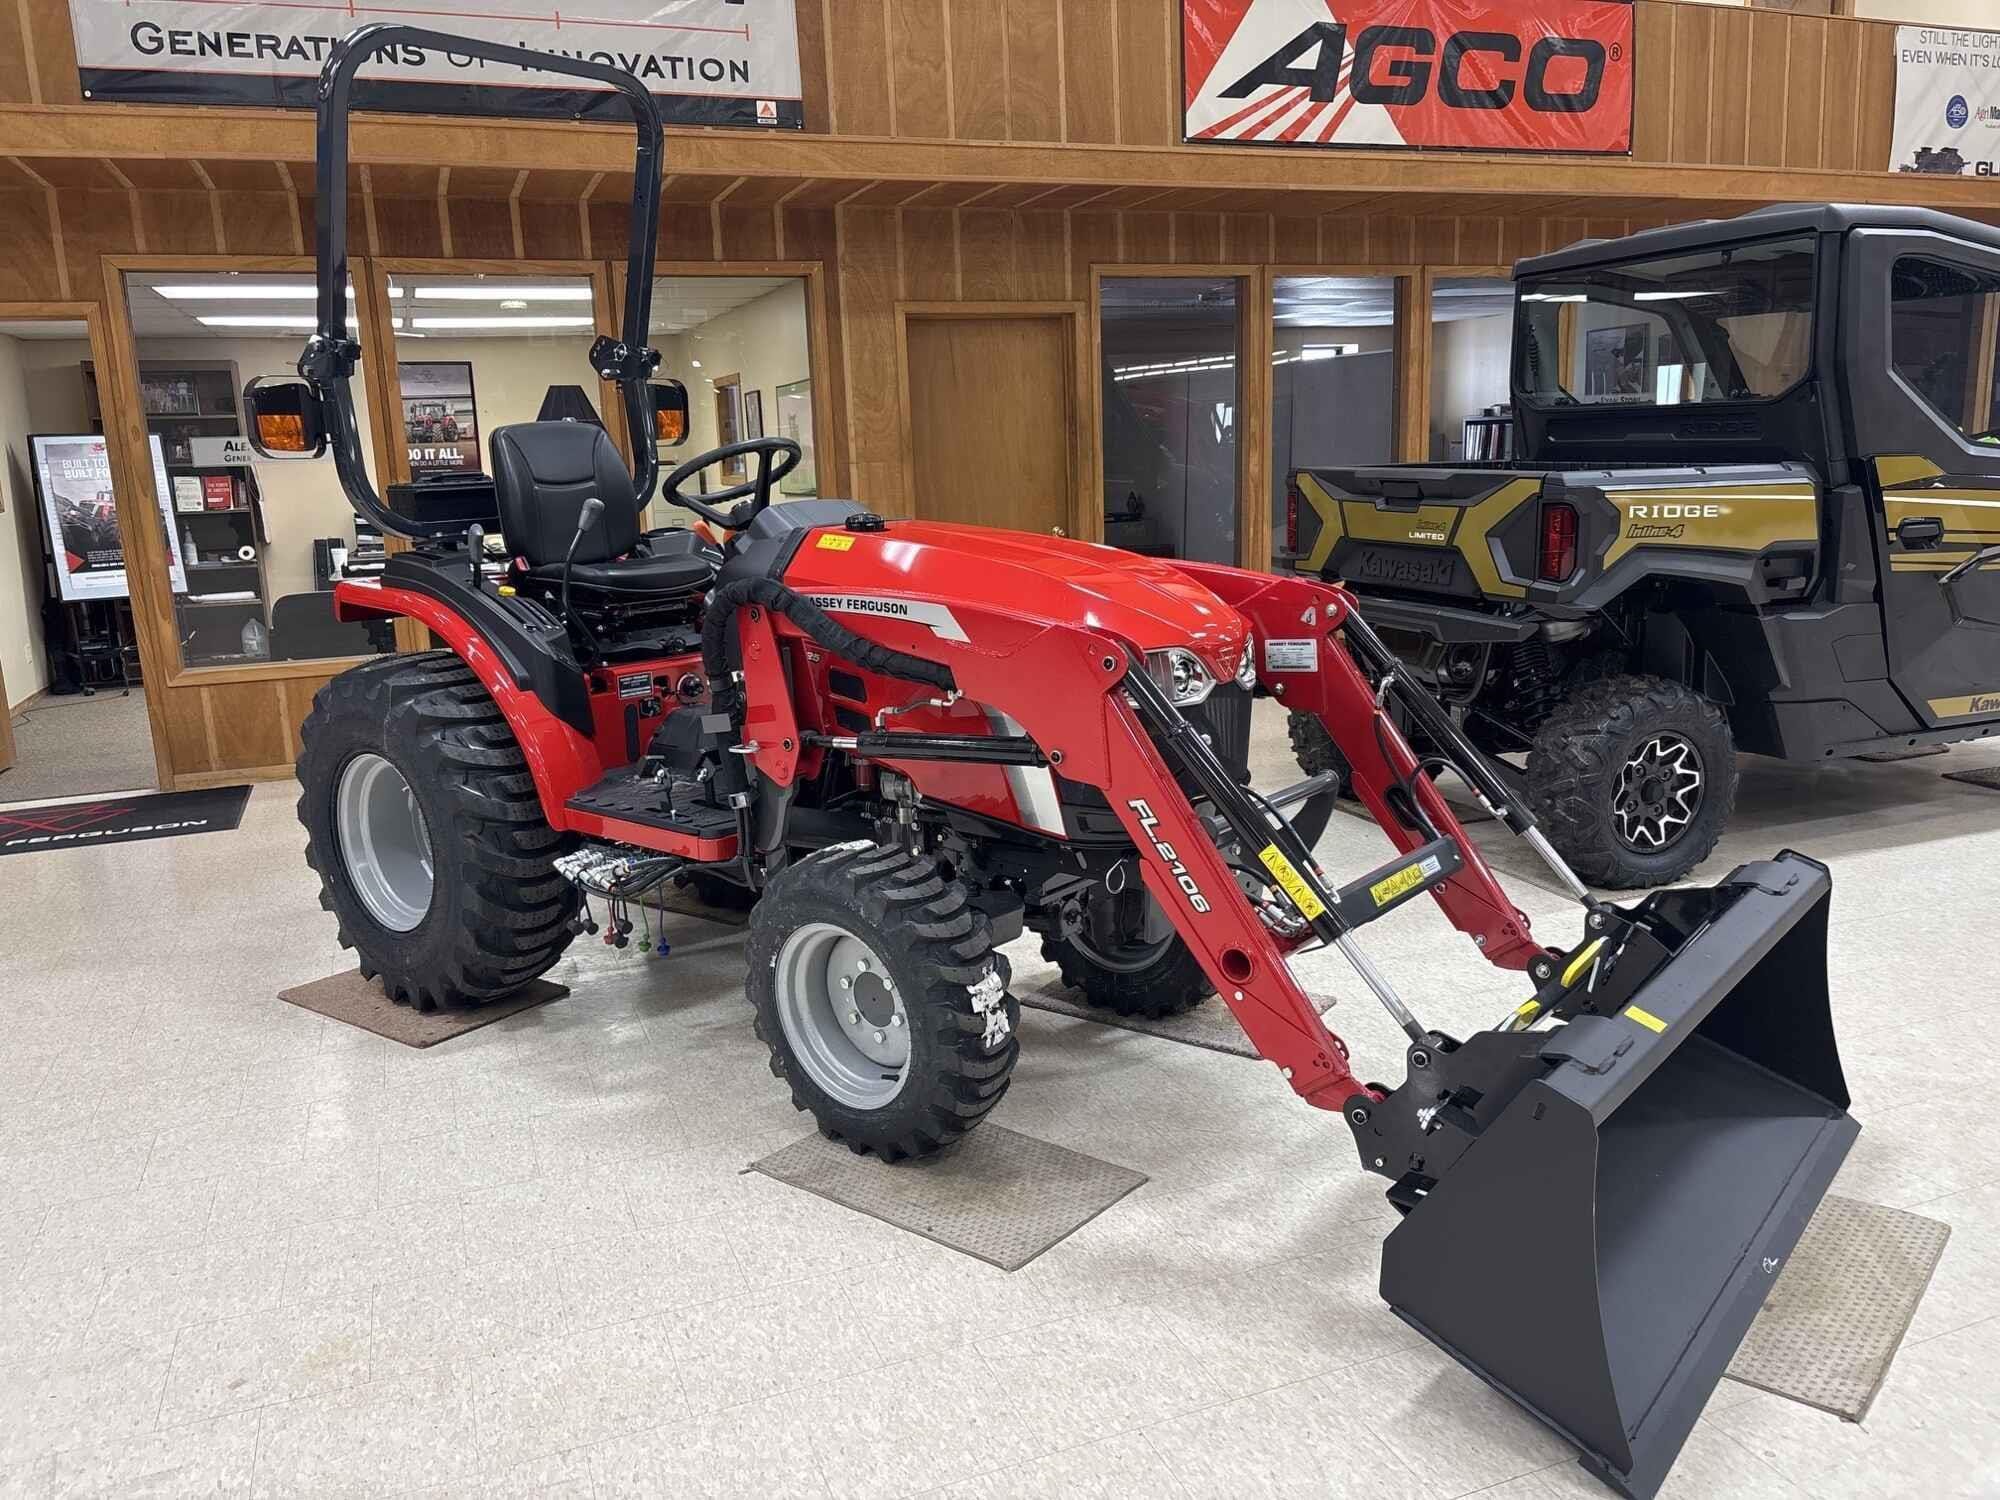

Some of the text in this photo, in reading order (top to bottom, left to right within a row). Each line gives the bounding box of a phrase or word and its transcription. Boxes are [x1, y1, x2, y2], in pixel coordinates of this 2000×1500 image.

[1920, 30, 1947, 45] STILL
[1951, 32, 1969, 47] THE
[1902, 49, 1932, 63] EVEN
[1935, 51, 1967, 66] WHEN
[1970, 54, 1990, 67] IT'S
[1217, 21, 1605, 113] AGCO
[64, 468, 94, 479] BUILT
[1628, 504, 1719, 519] RIDGE
[1408, 531, 1445, 541] LIMITED
[1358, 551, 1456, 585] Kawasaki
[846, 598, 908, 615] FERGUSON
[5, 818, 208, 847] FERGUSON
